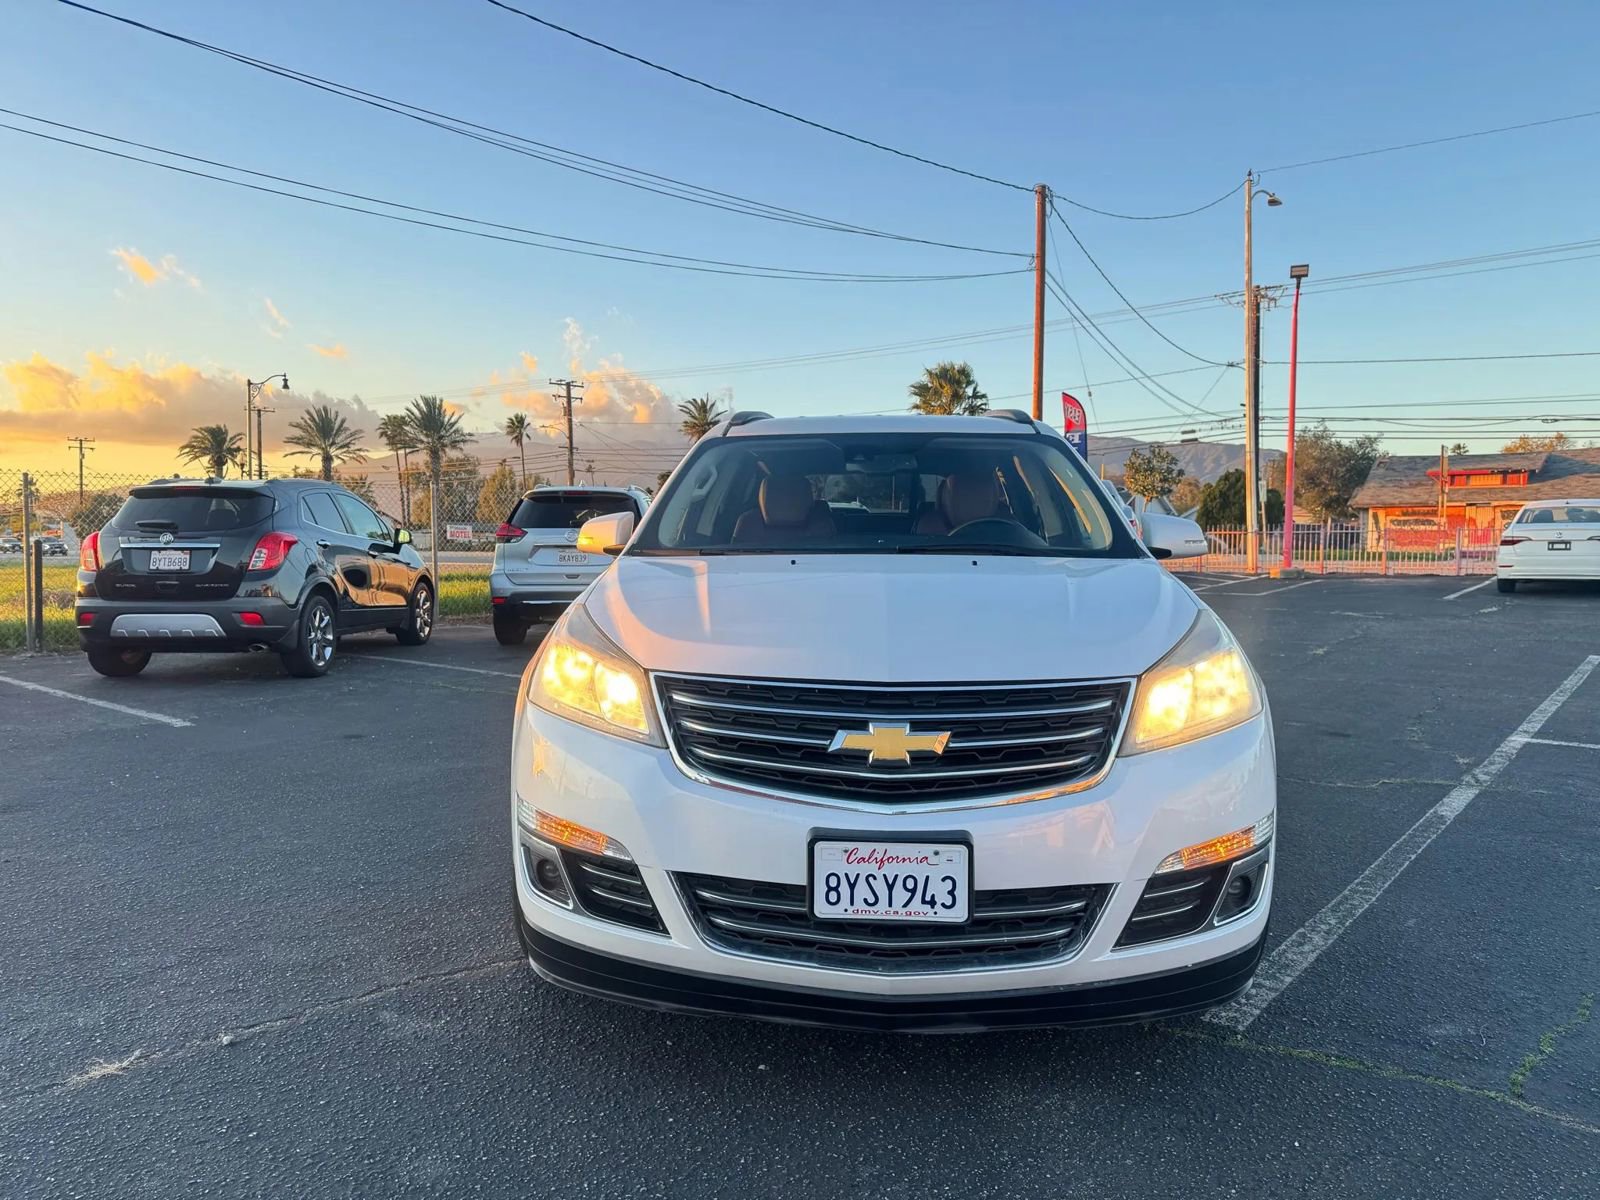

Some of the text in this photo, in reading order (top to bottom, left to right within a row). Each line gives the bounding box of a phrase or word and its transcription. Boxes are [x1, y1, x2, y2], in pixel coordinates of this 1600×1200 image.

[846, 848, 940, 870] California
[824, 872, 957, 910] 8YSY943
[852, 908, 929, 916] dmv.ca.gov
